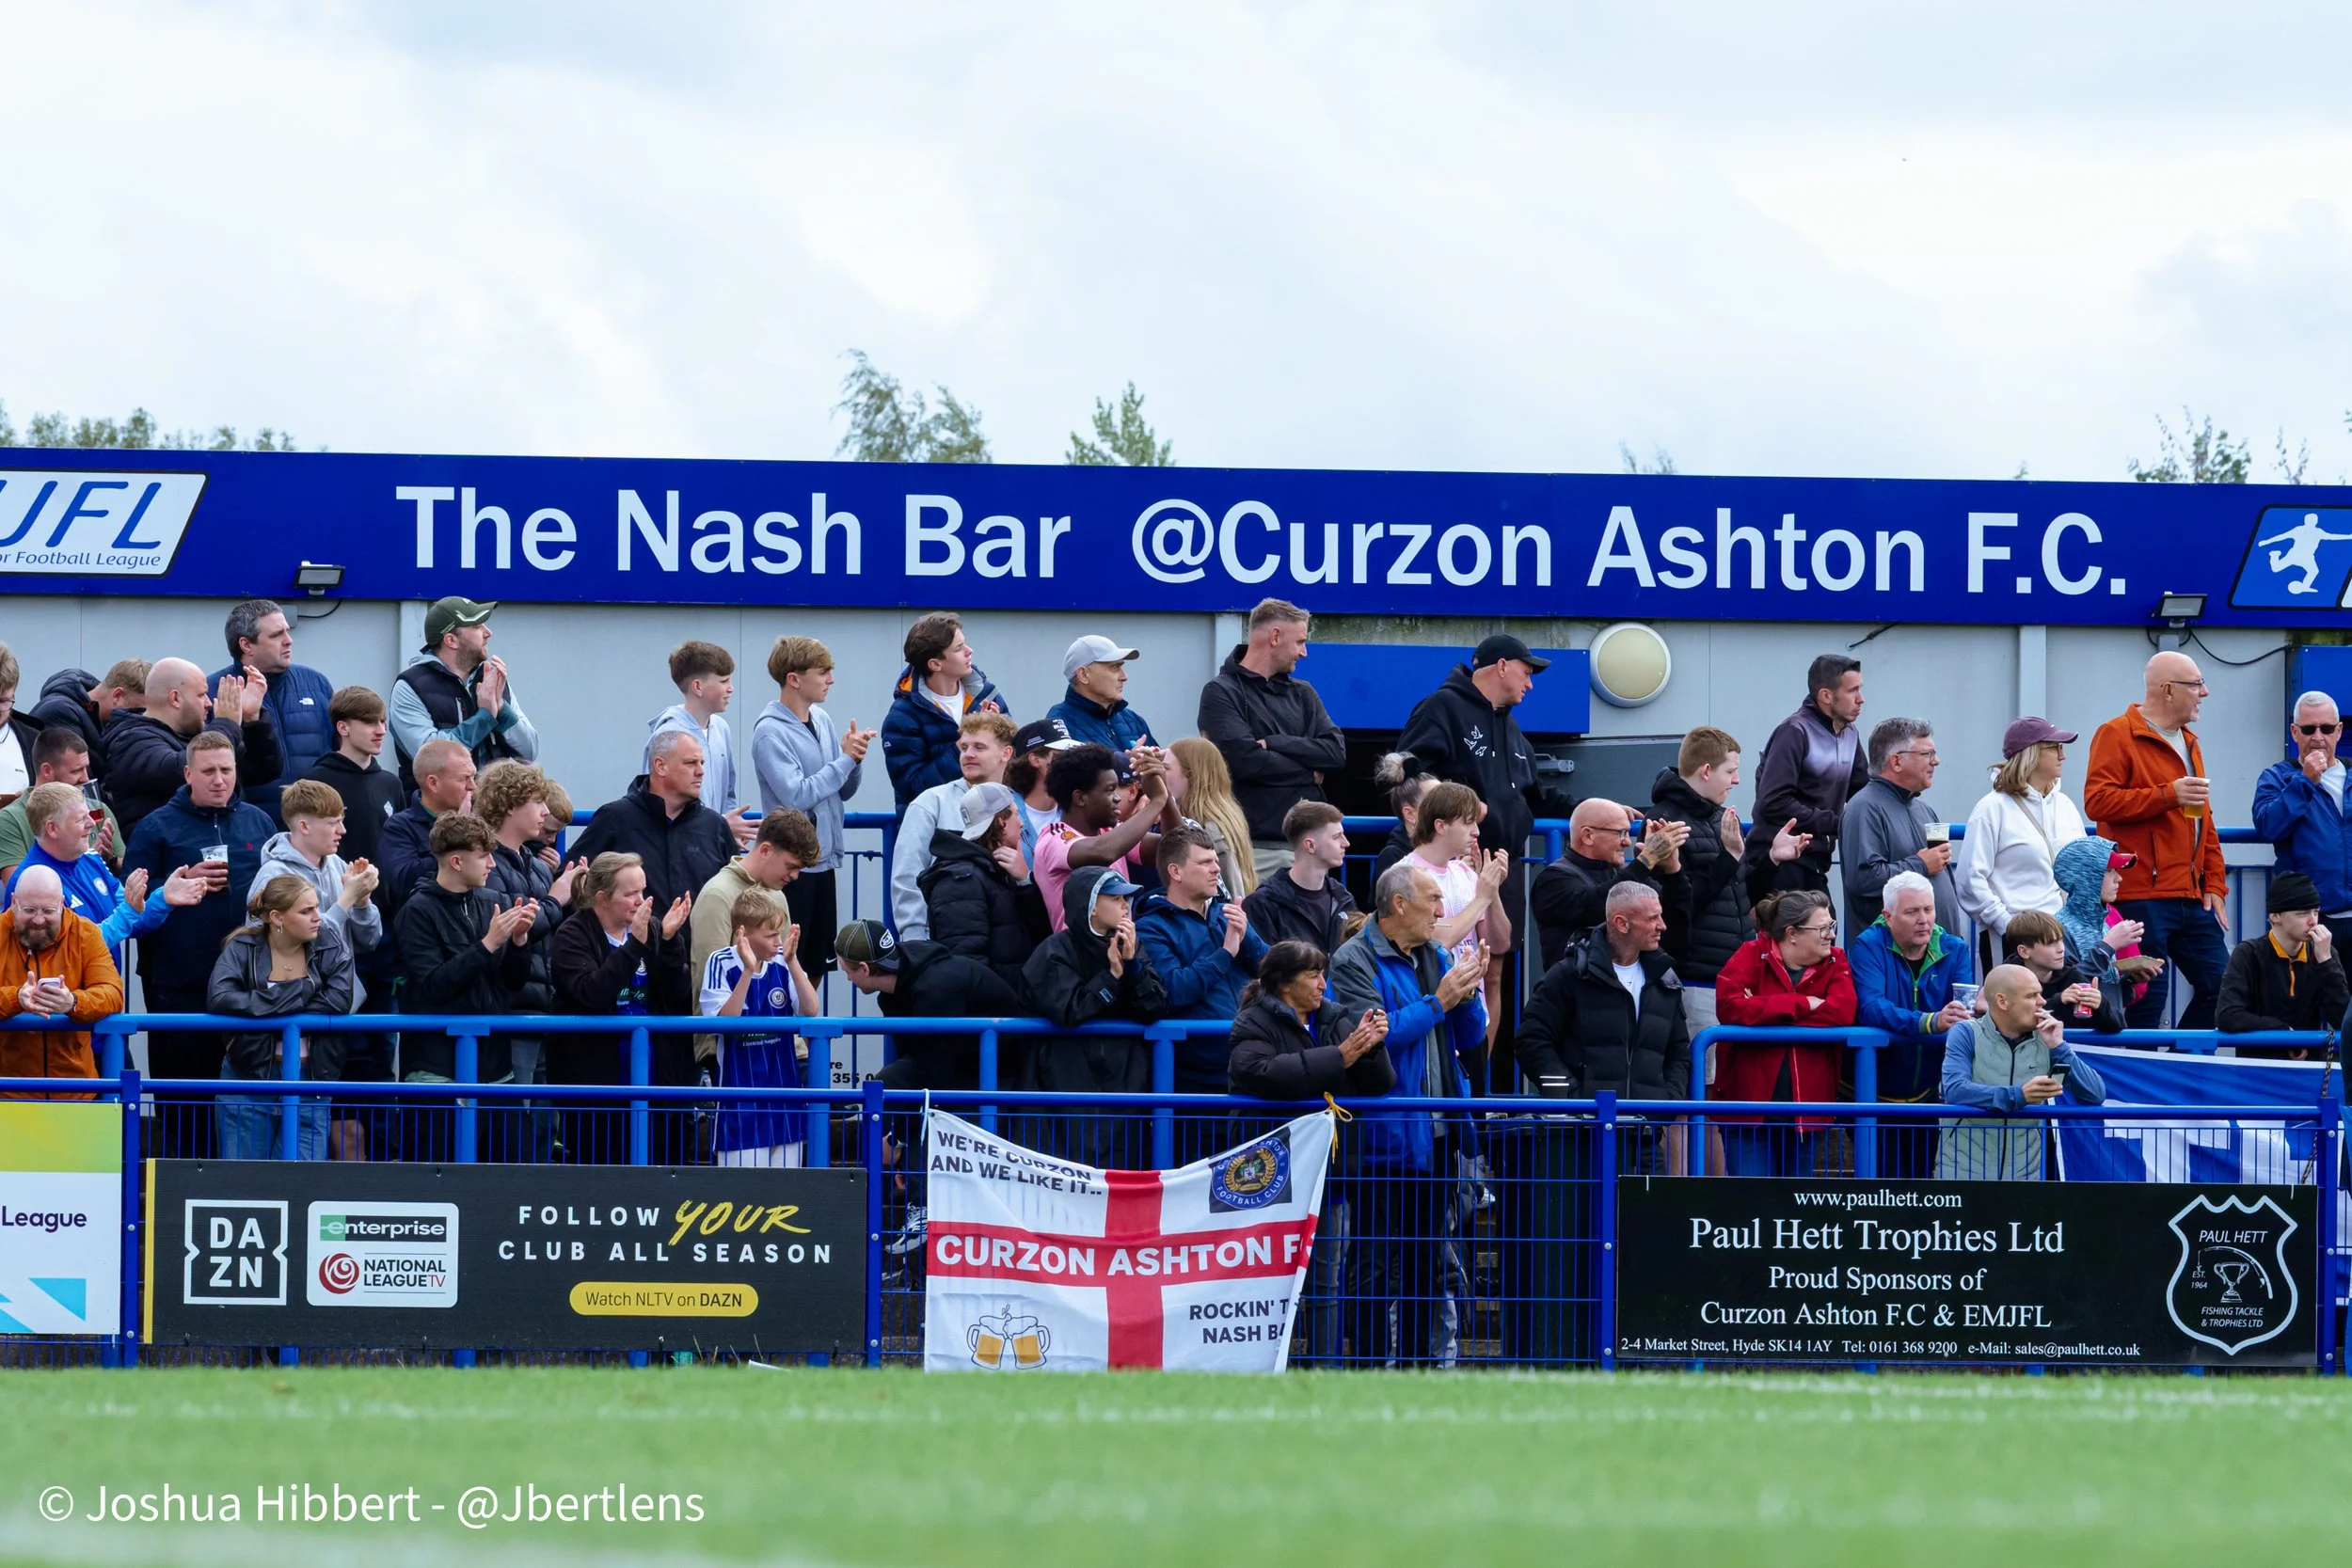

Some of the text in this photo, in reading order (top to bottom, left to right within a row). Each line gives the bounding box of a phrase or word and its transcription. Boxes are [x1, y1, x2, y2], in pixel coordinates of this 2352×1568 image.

[396, 486, 2125, 594] The Nash Bar @Curzon Ashton F.C.
[16, 552, 89, 564] Football
[97, 553, 160, 569] League
[937, 1131, 1091, 1180] WE'RE CURZON
[930, 1155, 974, 1174] AND
[978, 1162, 1011, 1180] WE
[1017, 1170, 1063, 1192] LIKE
[1216, 1174, 1284, 1205] FOOTBALL CLUB
[1794, 1189, 1962, 1211] www.paulhett.com
[2, 1206, 87, 1232] League
[323, 1219, 445, 1240] enterprise
[519, 1199, 812, 1246] FOLLOW YOUR
[1690, 1218, 2064, 1259] Paul Hett Trophies Ltd
[2200, 1230, 2267, 1243] PAUL HETT
[499, 1241, 830, 1263] CLUB ALL SEASON
[936, 1233, 1310, 1276] CURZON ASHTON F
[364, 1259, 446, 1272] NATIONAL
[1769, 1267, 1987, 1295] Proud Sponsors of
[2191, 1280, 2208, 1290] 1964
[586, 1291, 741, 1307] Watch NLTV on DAZN
[1189, 1300, 1275, 1321] ROCKIN'
[1701, 1302, 2051, 1327] Curzon Ashton F.C & EMJFL
[2201, 1307, 2264, 1316] FISHING TACKLE
[1203, 1323, 1285, 1344] NASH B
[2210, 1319, 2247, 1327] TROPHIES
[1622, 1338, 2139, 1357] 2-4 Market Street, Hyde SK14 1AY Tel: 0161 368 9200 e-Mail: sales@paulhett.co.uk
